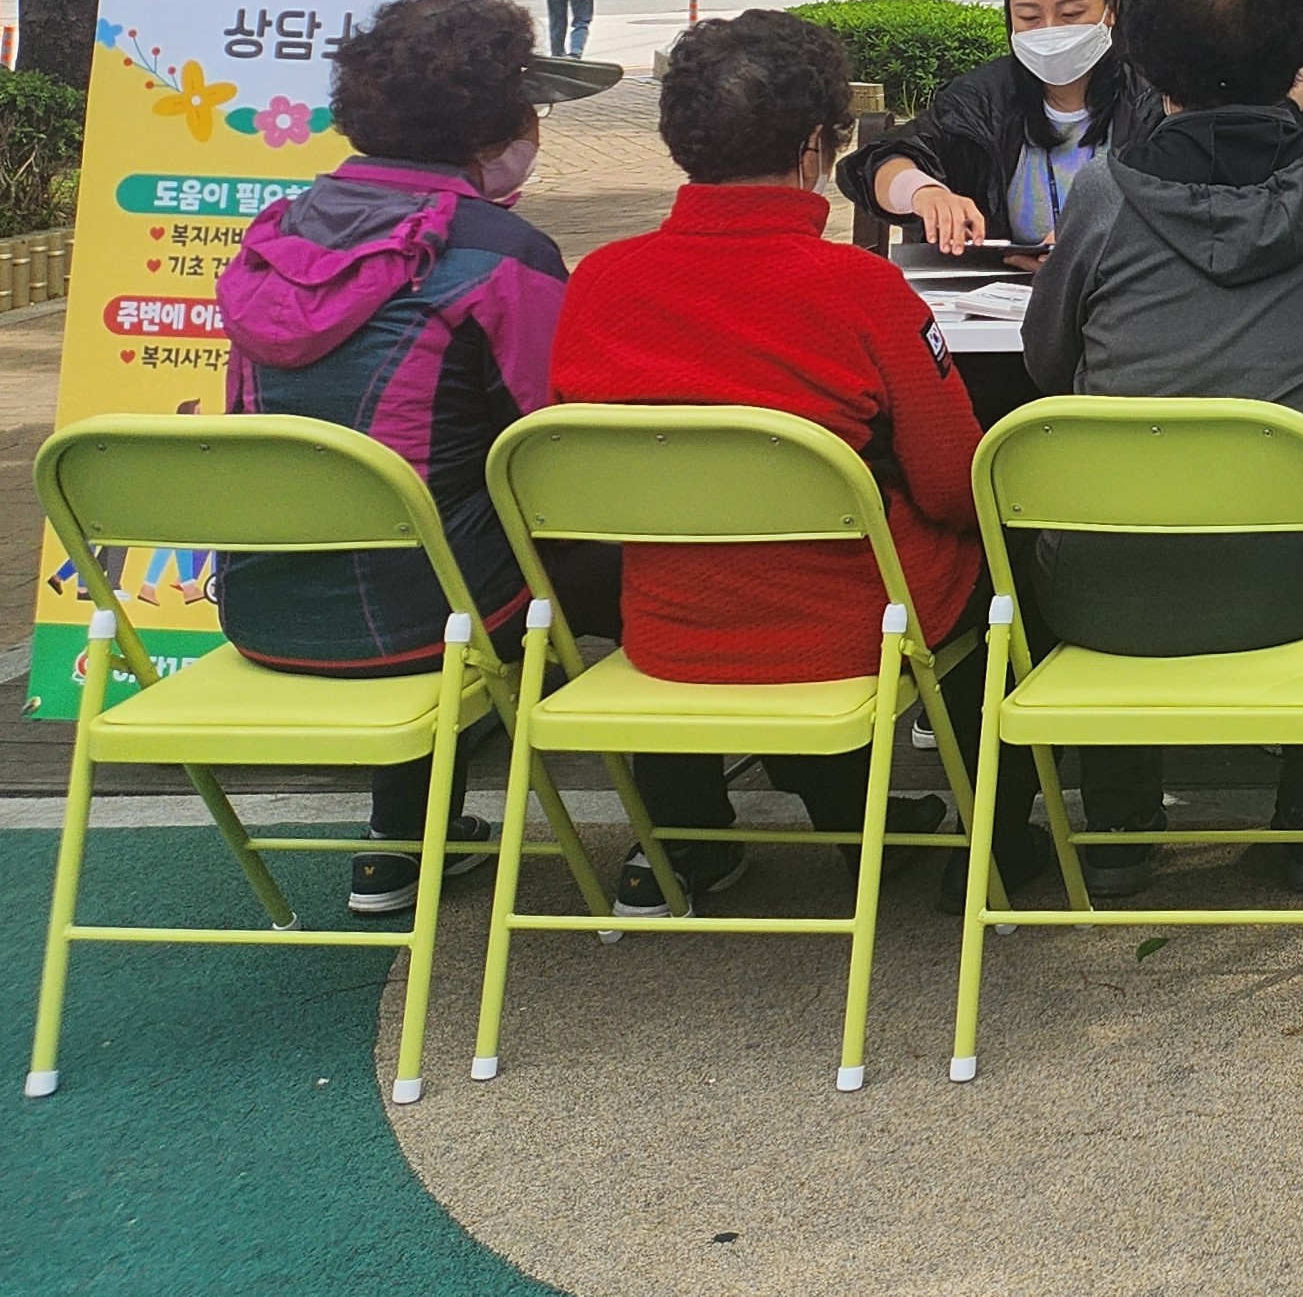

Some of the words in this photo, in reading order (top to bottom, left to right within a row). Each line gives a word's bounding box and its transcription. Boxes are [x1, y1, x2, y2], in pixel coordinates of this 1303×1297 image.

[154, 179, 227, 212] 도움이
[168, 255, 204, 277] 기초
[117, 300, 185, 332] 주변에
